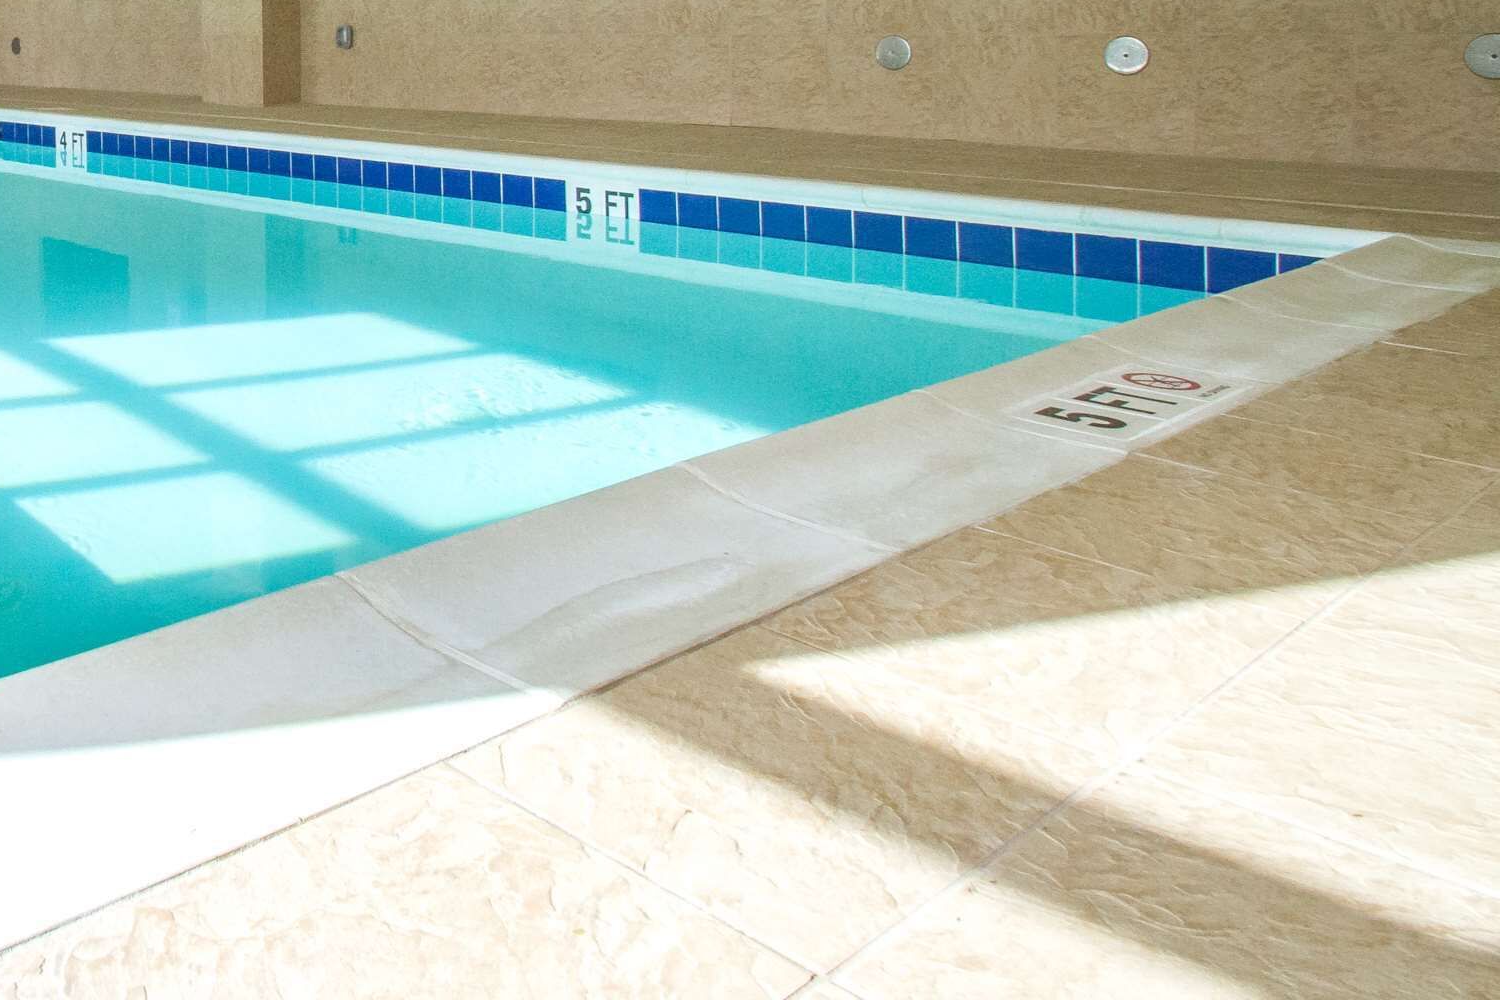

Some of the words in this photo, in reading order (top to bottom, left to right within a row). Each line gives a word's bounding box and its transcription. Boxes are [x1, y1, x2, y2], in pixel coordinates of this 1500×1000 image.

[59, 131, 67, 149] 4
[72, 132, 85, 150] FT
[576, 187, 592, 214] 5
[605, 190, 634, 219] FT
[1072, 386, 1178, 415] FT
[1033, 406, 1128, 429] 5
